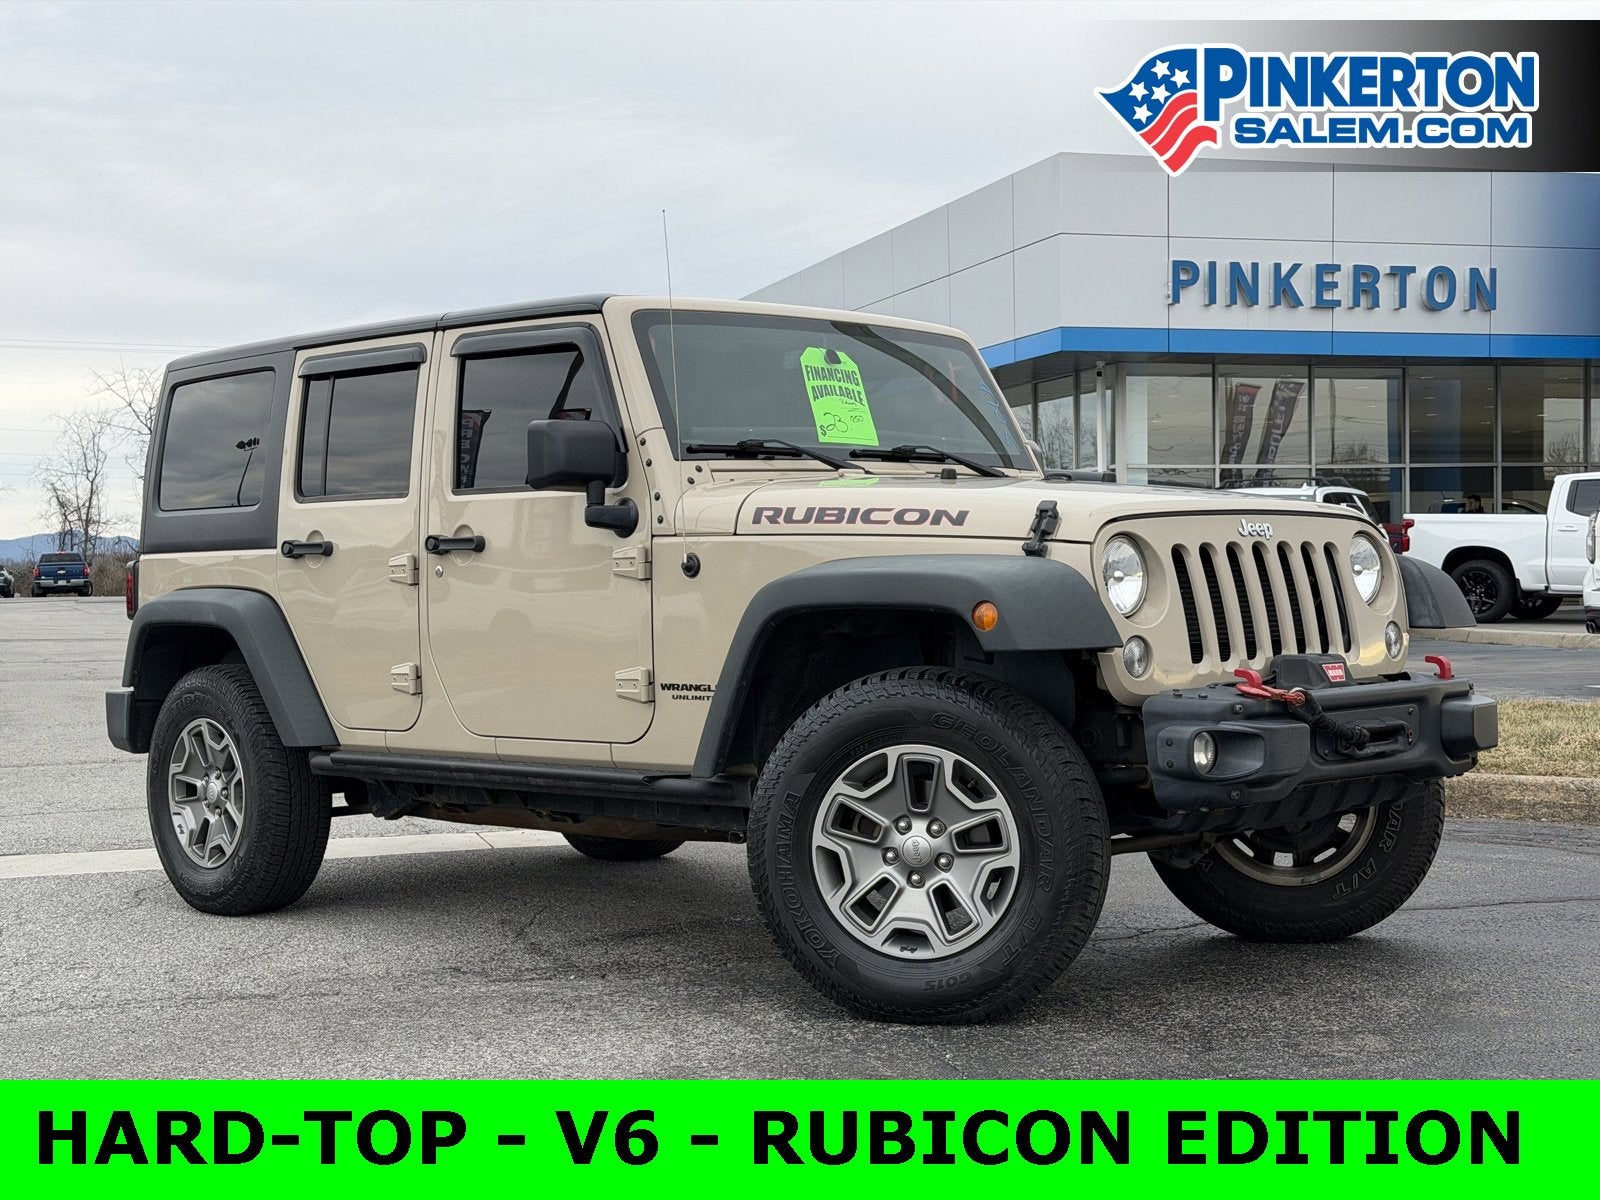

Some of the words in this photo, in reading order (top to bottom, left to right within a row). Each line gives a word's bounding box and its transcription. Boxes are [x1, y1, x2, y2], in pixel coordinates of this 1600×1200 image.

[1169, 260, 1498, 311] PINKERTON
[804, 365, 860, 387] FINANCING
[811, 384, 866, 407] AVAILABLE
[752, 507, 969, 526] RUBICON
[1238, 518, 1273, 540] Jeep
[660, 683, 716, 692] WRANGL
[776, 790, 842, 970] YOKOHAMA
